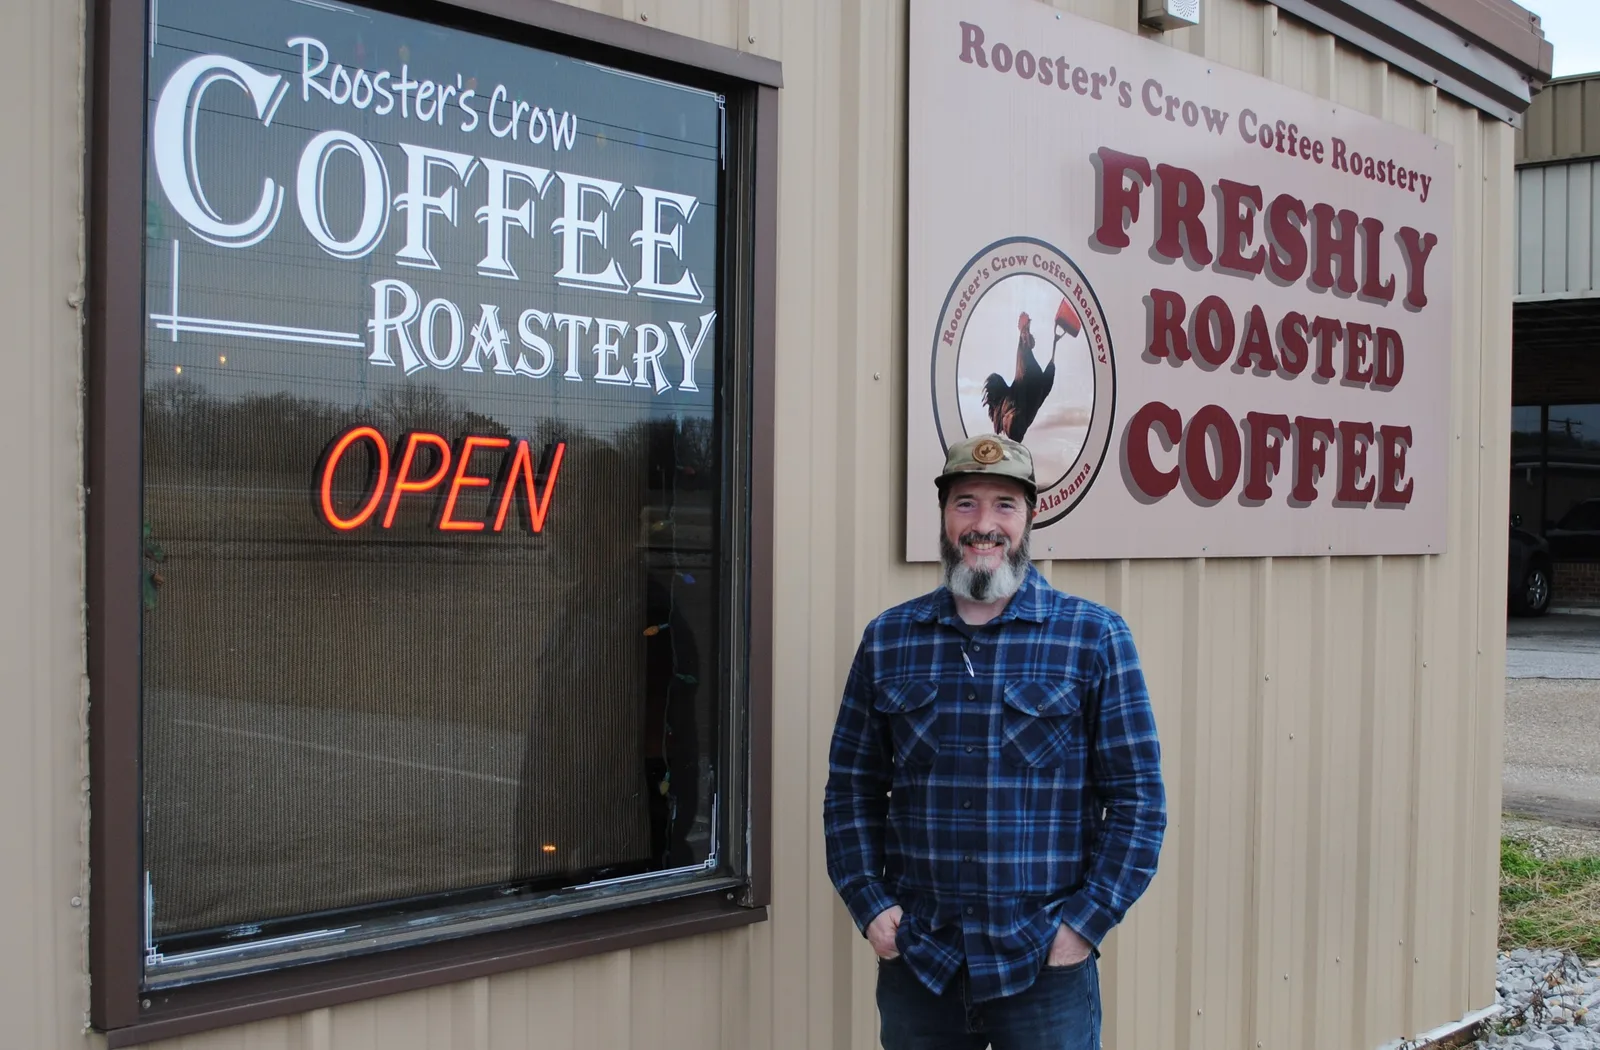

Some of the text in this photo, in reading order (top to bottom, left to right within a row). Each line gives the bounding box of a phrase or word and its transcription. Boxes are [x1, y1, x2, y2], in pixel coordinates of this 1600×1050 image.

[287, 36, 577, 151] Rooster's Crow
[959, 20, 1432, 203] Rooster's Crow Coffee Roastery
[1088, 146, 1438, 313] FRESHLY
[991, 254, 1029, 272] Crow
[1032, 254, 1072, 288] Coffee
[1072, 283, 1107, 365] Roastery
[1141, 288, 1405, 392] ROASTED
[321, 426, 565, 533] OPEN
[1038, 462, 1091, 513] Alabama
[1120, 400, 1414, 511] COFFEE
